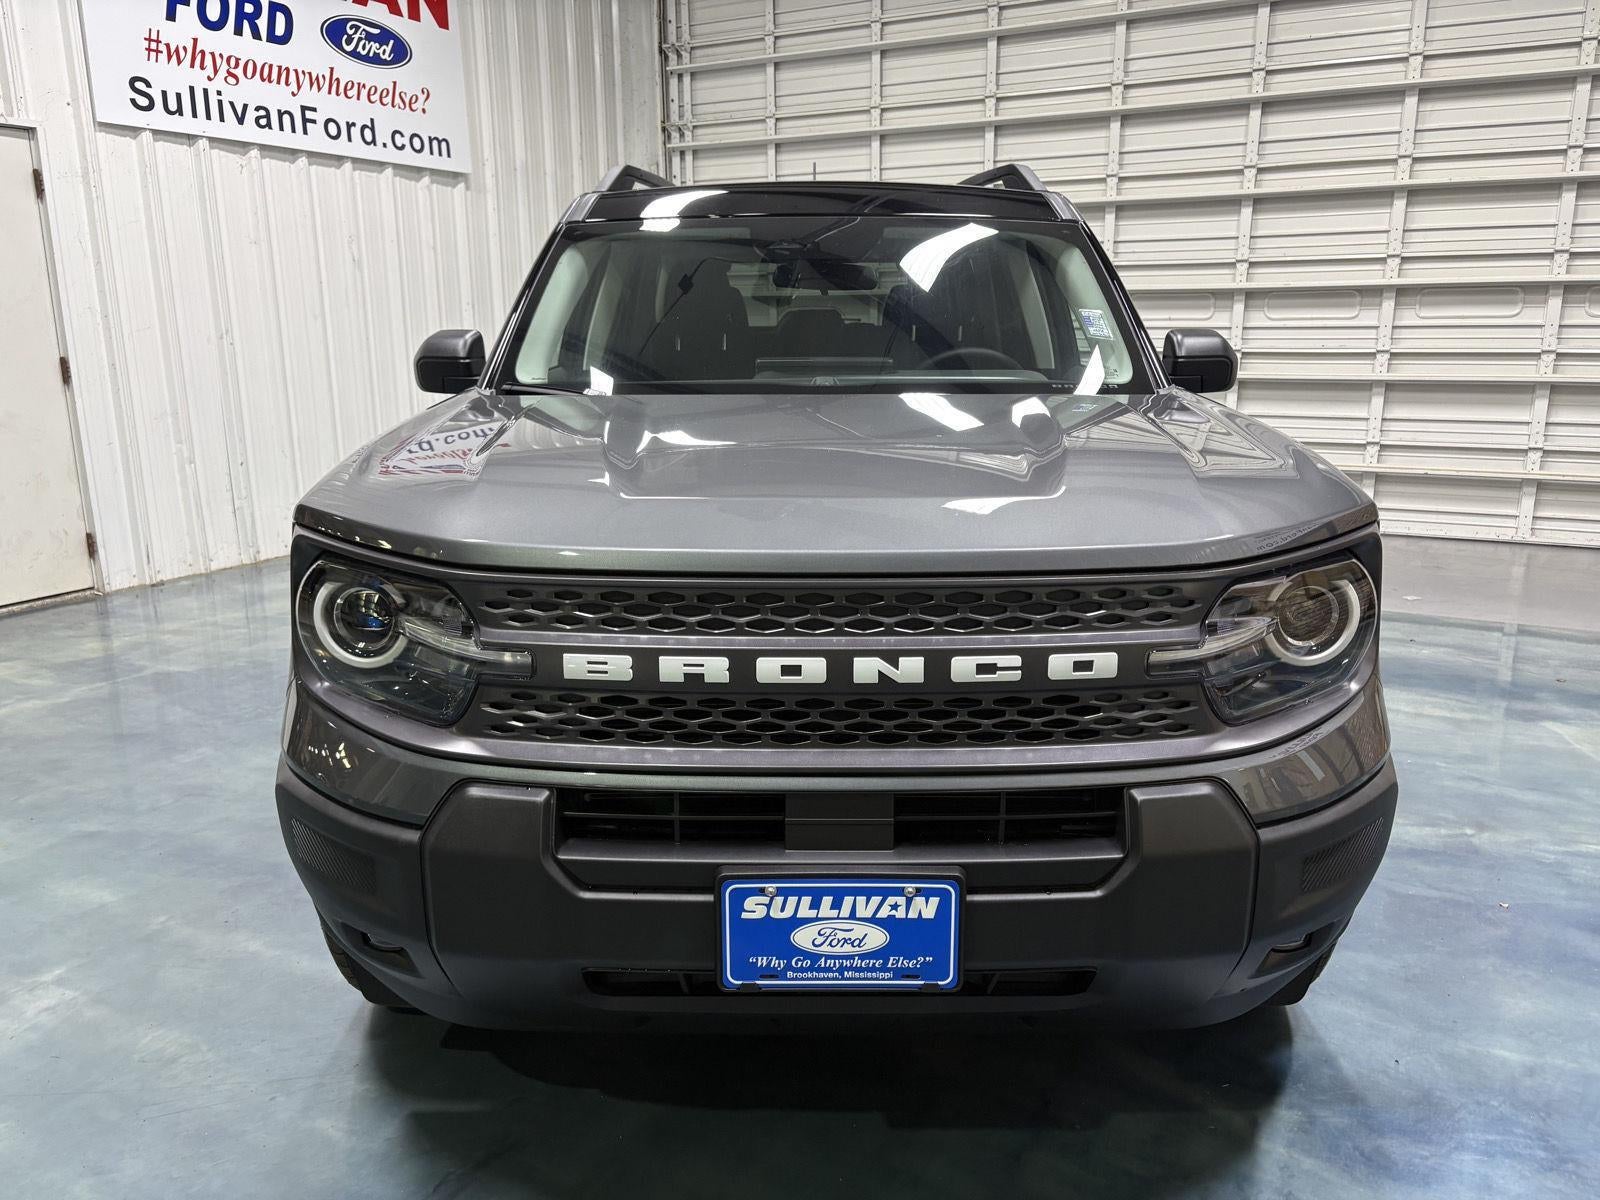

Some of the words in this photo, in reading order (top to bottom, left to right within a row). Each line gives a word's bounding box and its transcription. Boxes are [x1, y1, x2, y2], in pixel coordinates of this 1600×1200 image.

[341, 19, 395, 63] Ford
[143, 27, 431, 114] #whygoanywhereelse?
[128, 75, 452, 158] SullivanFord.com
[562, 652, 1118, 684] BRONCO
[741, 895, 941, 919] SULLIVAN
[811, 926, 869, 949] Ford
[787, 971, 842, 980] Brookhaven,
[844, 971, 893, 980] Mississippi
[791, 956, 811, 968] Go
[815, 956, 883, 970] Anywhere
